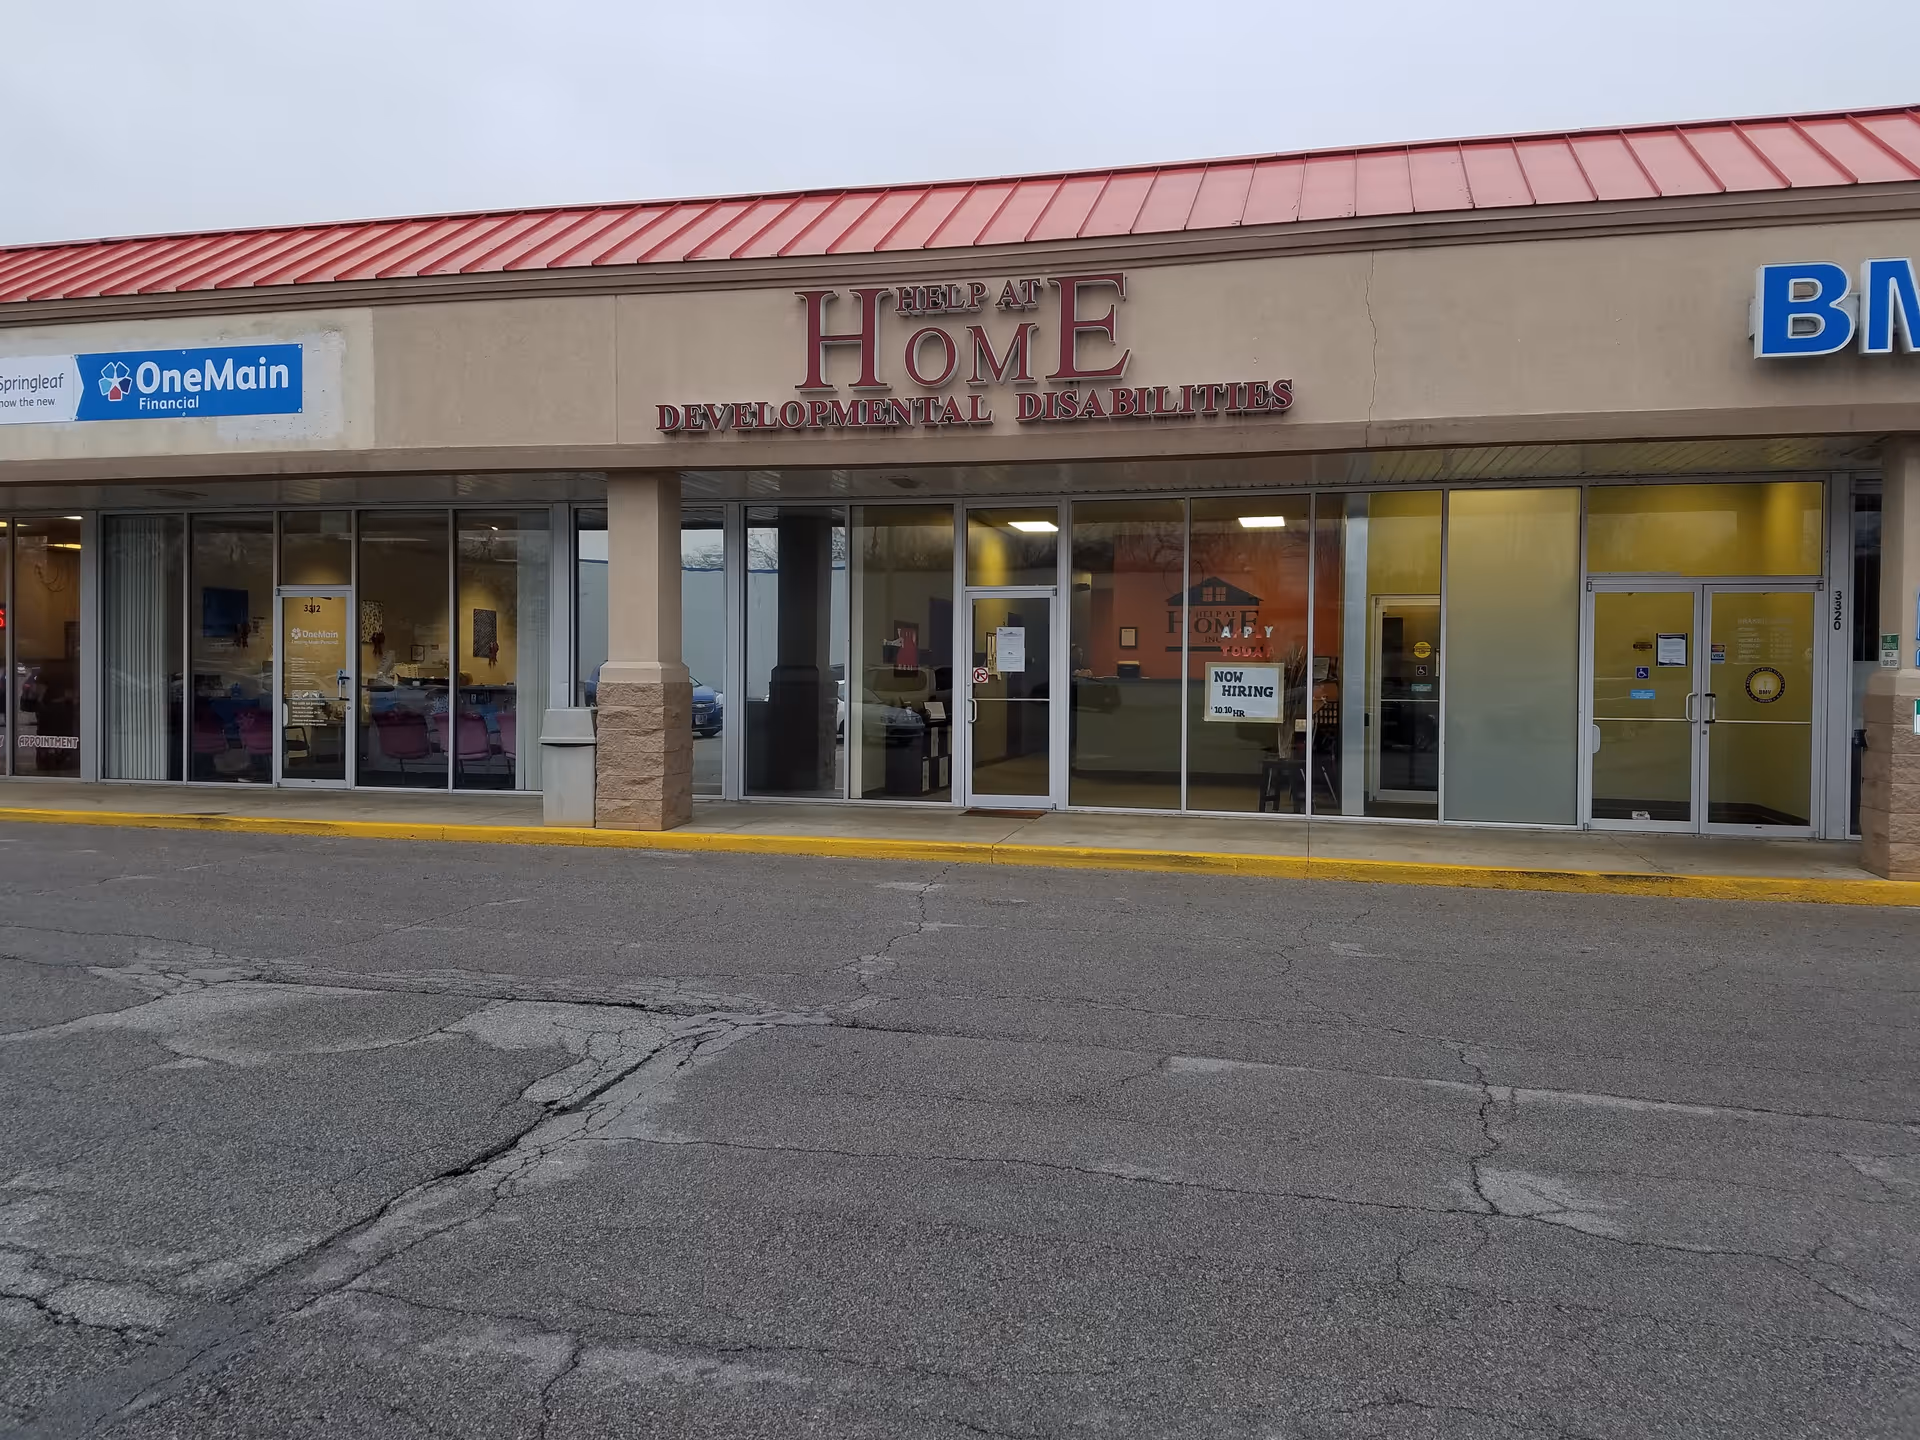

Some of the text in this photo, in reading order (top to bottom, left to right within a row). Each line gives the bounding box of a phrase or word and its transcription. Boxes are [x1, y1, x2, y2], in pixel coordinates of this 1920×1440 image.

[894, 278, 1042, 314] HELP AT
[795, 272, 1131, 392] HOME
[136, 356, 290, 394] OneMain
[19, 397, 34, 407] the
[37, 398, 56, 406] new
[139, 396, 200, 411] Financial
[655, 378, 1295, 432] DEVELOPMENTAL DISABILITIES
[1224, 610, 1237, 618] AT
[1833, 590, 1843, 631] 3320
[1214, 671, 1243, 683] NOW
[1221, 685, 1274, 698] HIRING
[18, 735, 79, 749] APPOINTMENT
